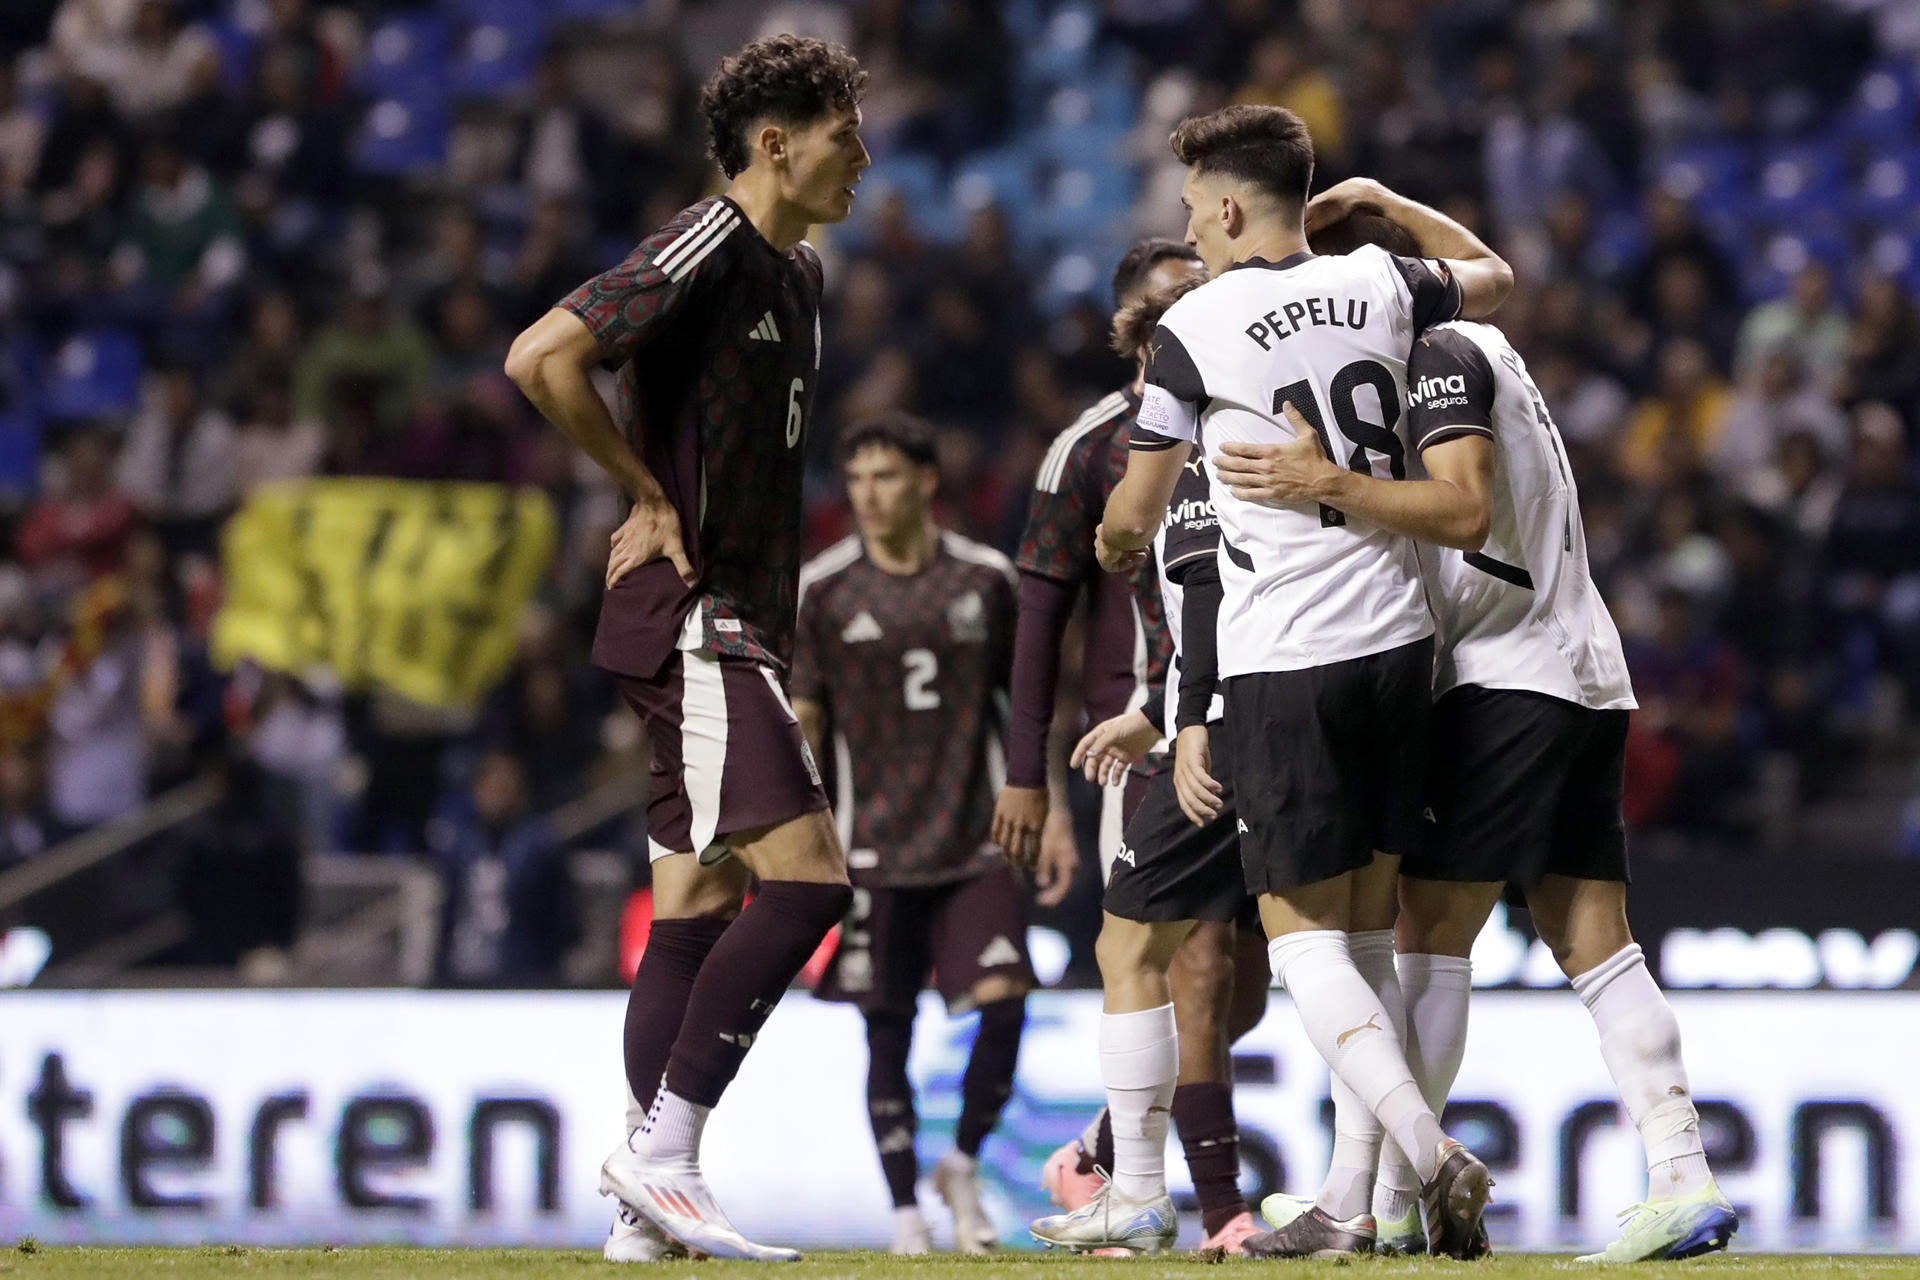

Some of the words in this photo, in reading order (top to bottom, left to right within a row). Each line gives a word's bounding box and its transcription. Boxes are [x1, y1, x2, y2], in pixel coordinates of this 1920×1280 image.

[1245, 298, 1367, 351] PEPELU
[786, 377, 804, 448] 6
[1407, 375, 1466, 410] ivina
[1427, 396, 1469, 410] seguros
[1272, 360, 1406, 528] 18
[1185, 518, 1219, 530] seguro
[902, 649, 940, 710] 2
[26, 1052, 563, 1212] teren
